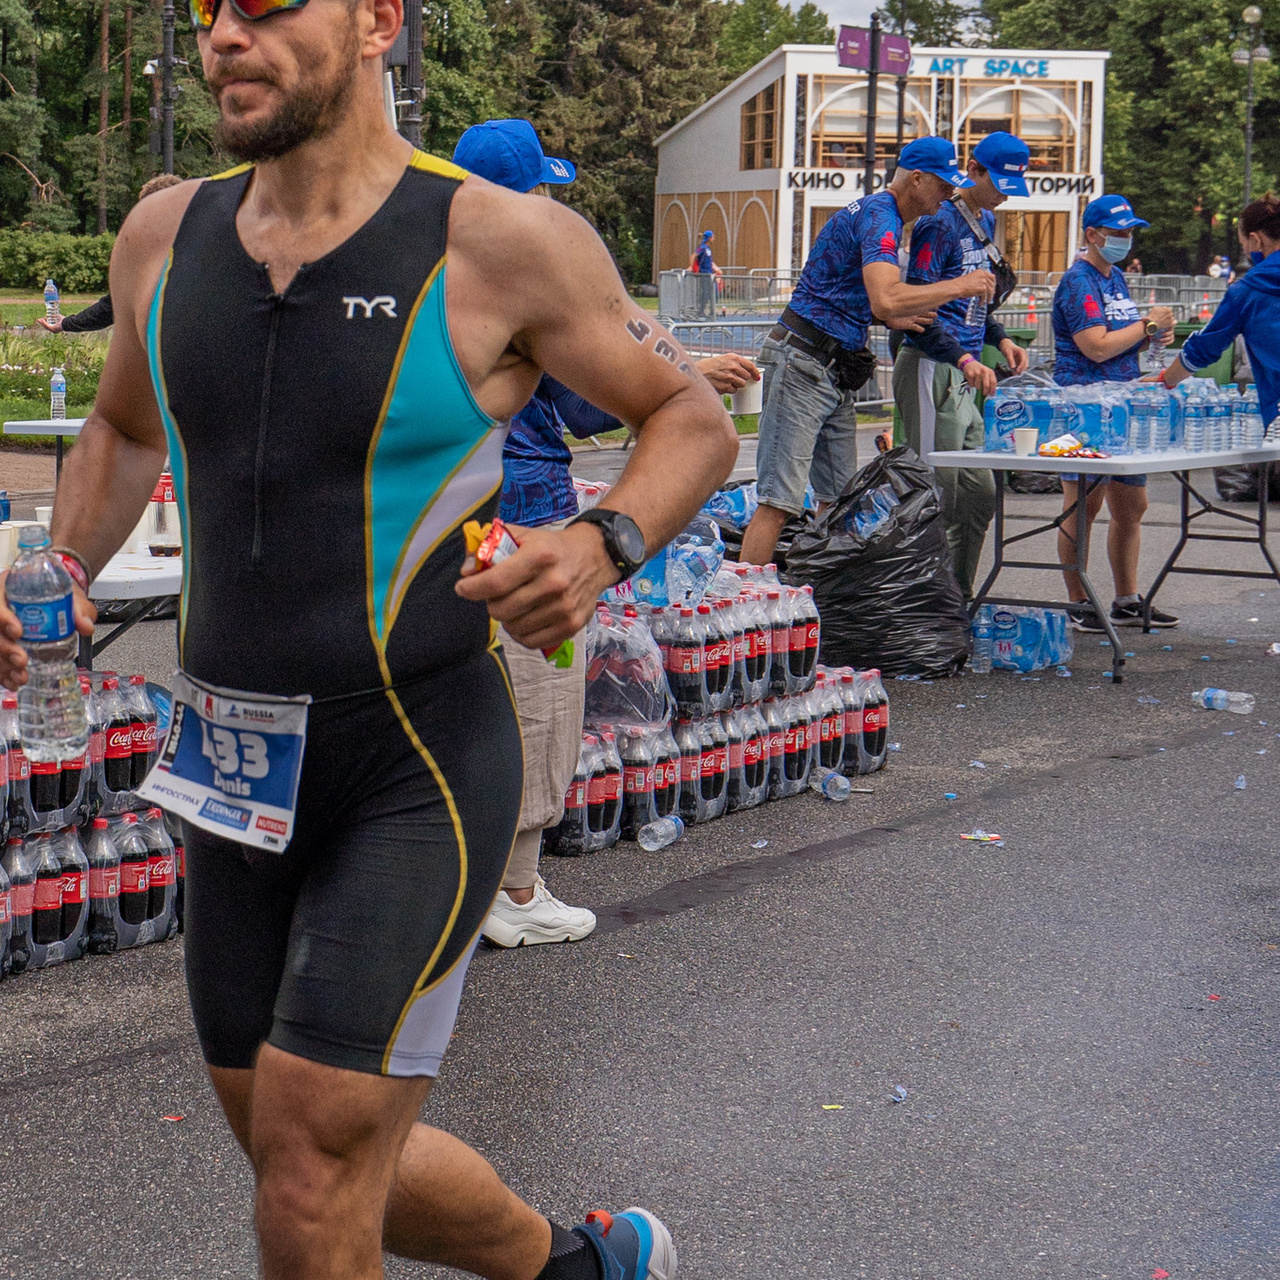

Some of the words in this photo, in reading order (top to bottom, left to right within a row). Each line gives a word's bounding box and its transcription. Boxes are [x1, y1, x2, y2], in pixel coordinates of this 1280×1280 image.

[929, 58, 968, 74] ART
[985, 59, 1049, 77] SPACE
[788, 172, 845, 189] КИНО
[1025, 173, 1095, 193] ТОРИЙ
[342, 295, 398, 319] TYR
[243, 707, 275, 719] RUSSIA
